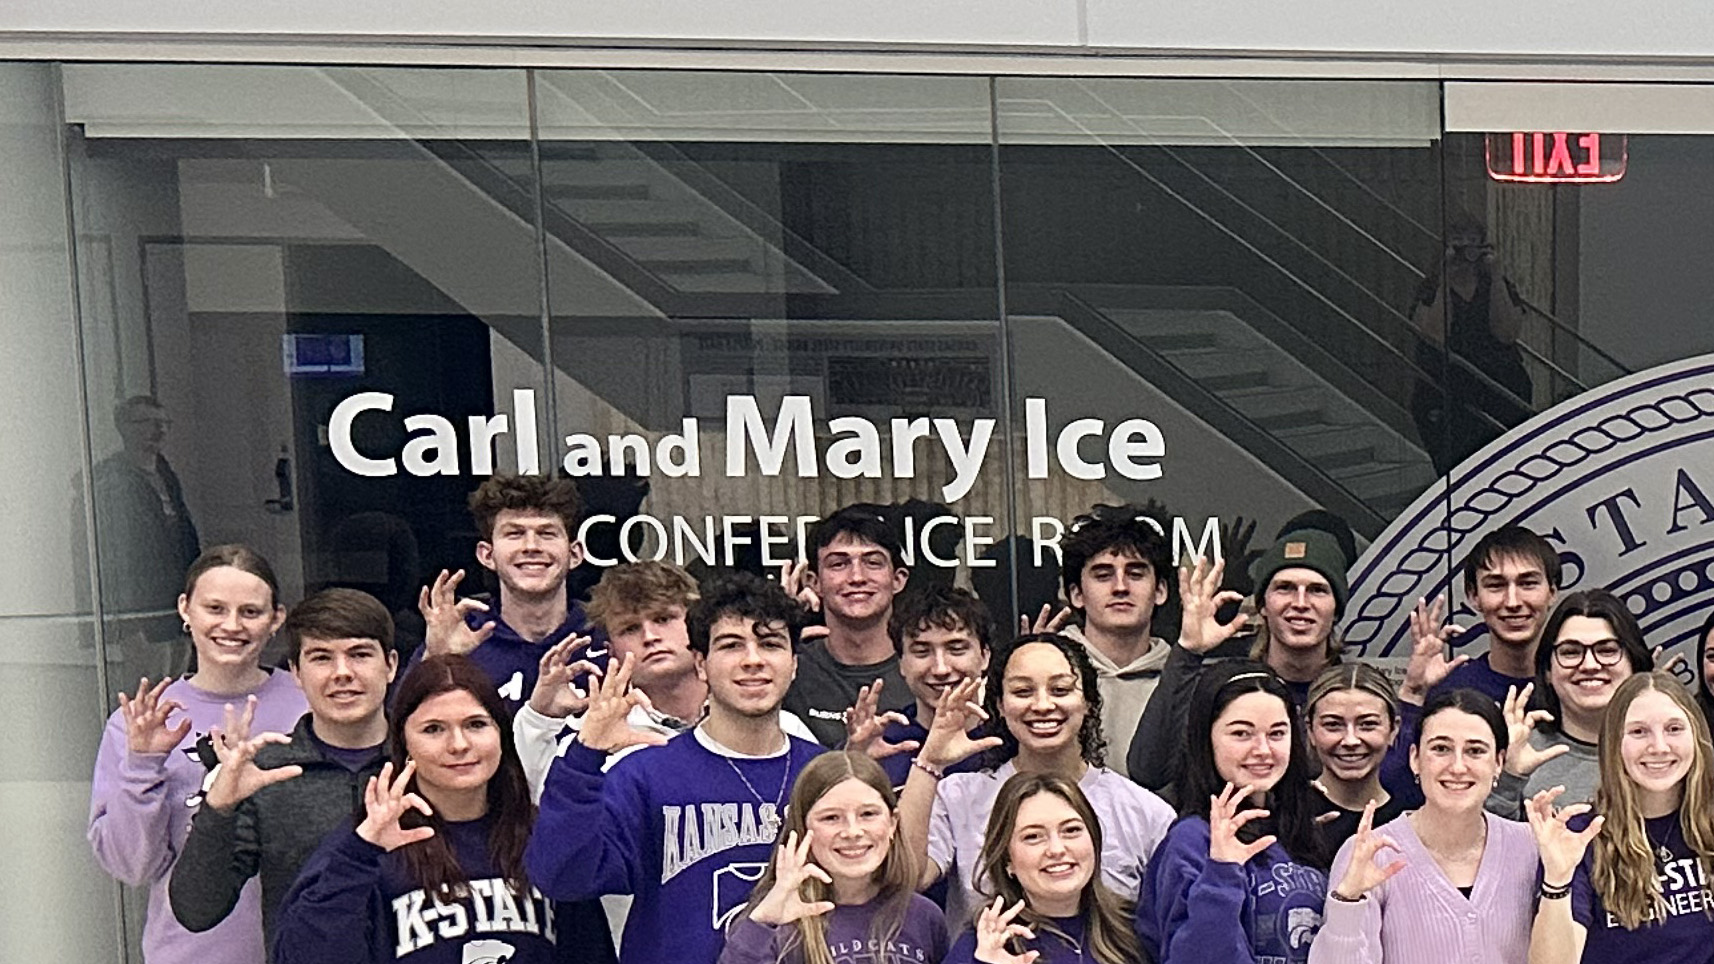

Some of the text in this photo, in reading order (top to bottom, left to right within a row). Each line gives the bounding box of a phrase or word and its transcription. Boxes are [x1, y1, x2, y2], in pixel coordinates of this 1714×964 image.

[328, 389, 1167, 503] Carl and Mary Ice
[1033, 516, 1224, 568] RM
